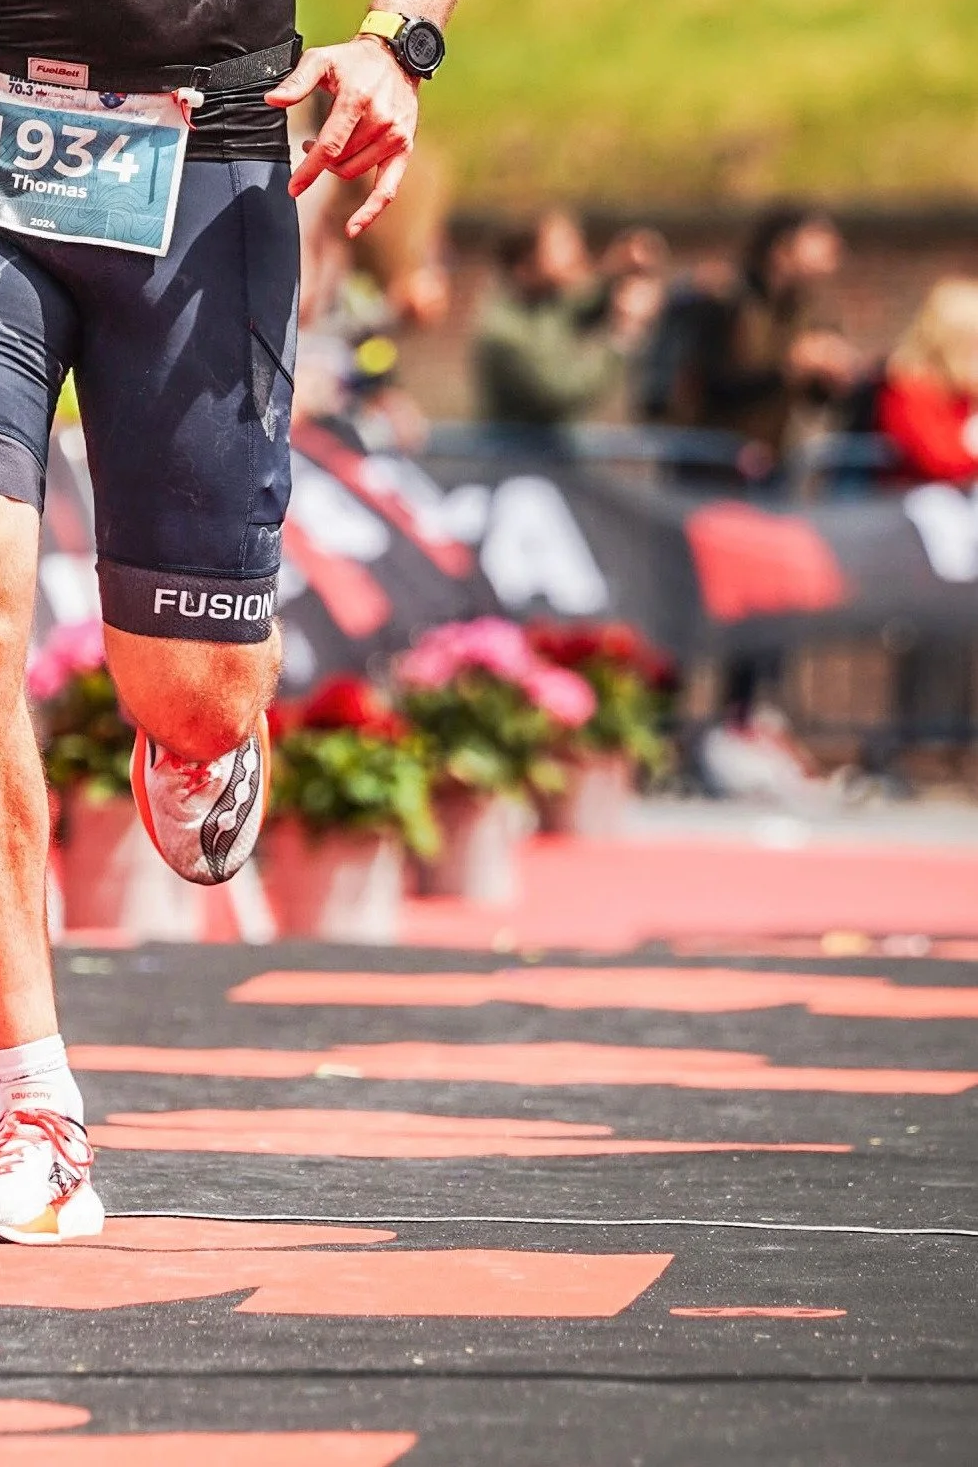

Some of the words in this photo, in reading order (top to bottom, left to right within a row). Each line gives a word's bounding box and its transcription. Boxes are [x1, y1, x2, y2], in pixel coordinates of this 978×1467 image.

[36, 65, 80, 78] FuelBelt
[8, 82, 34, 97] 70.3
[11, 173, 88, 199] Thomas
[29, 217, 57, 230] 2024
[153, 588, 275, 622] FUSION
[10, 1091, 52, 1100] saucony
